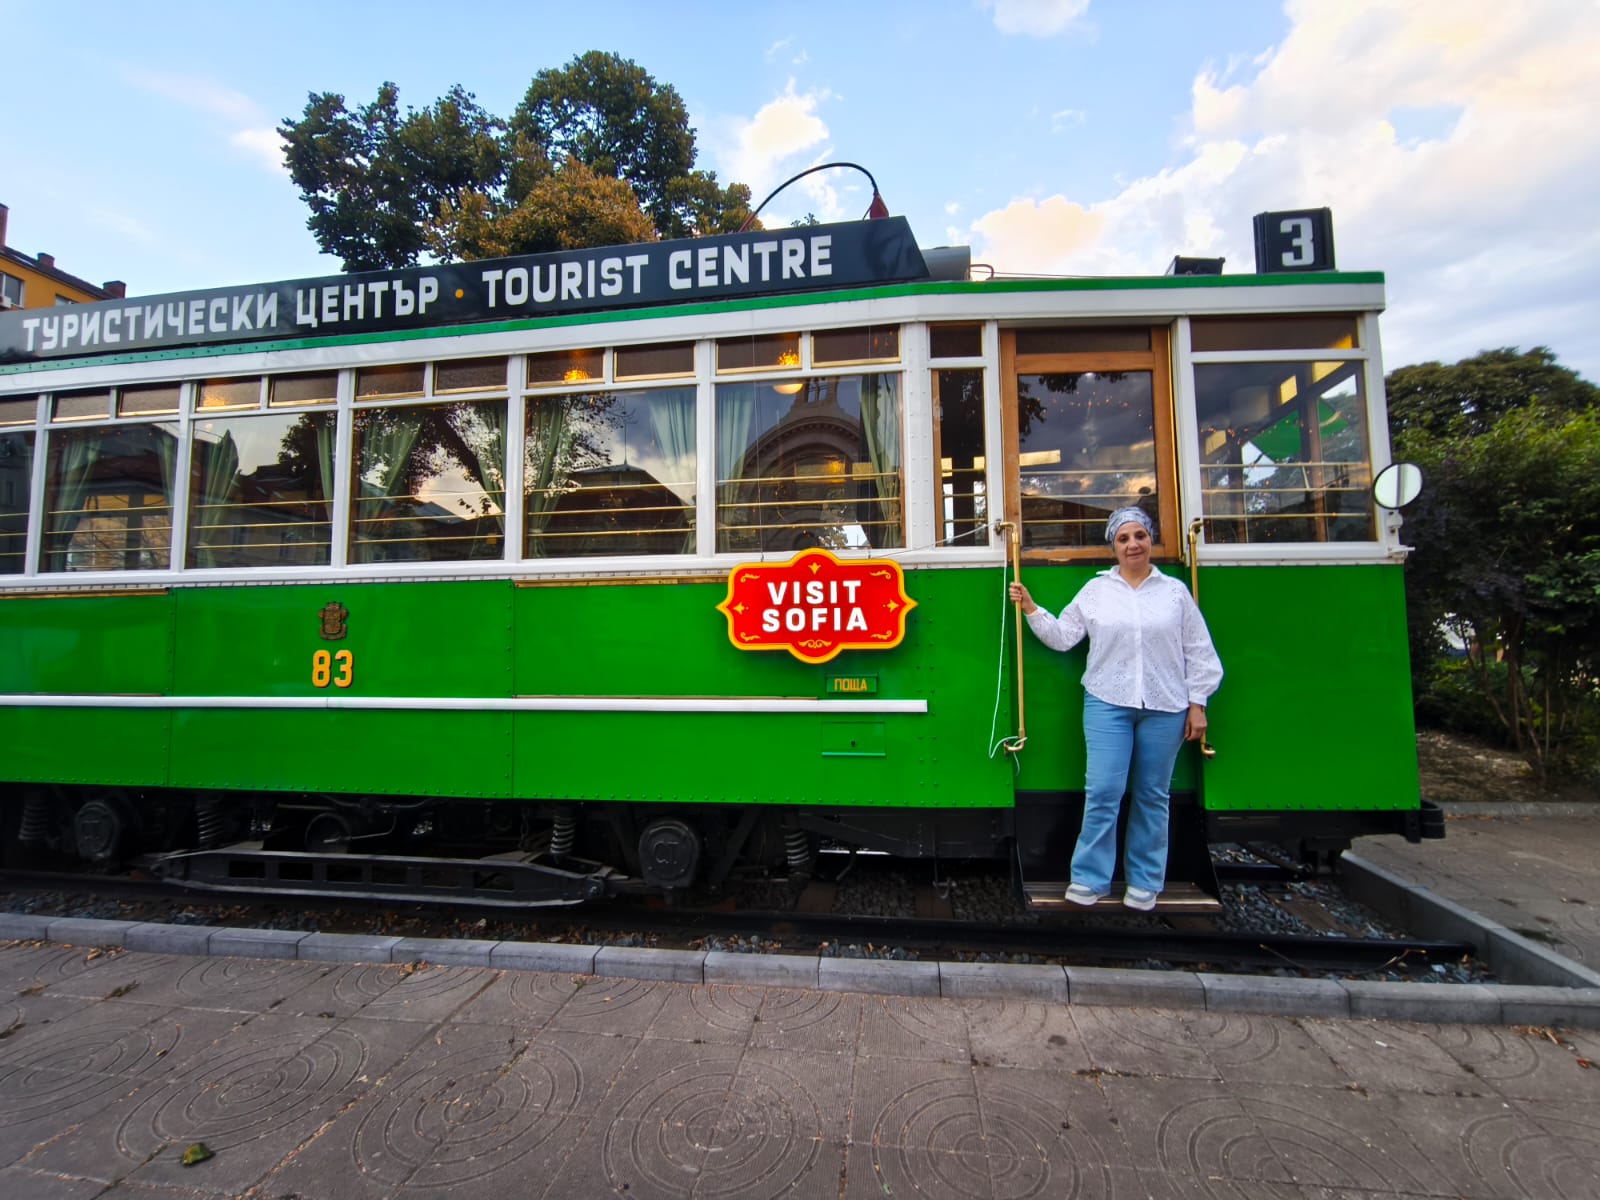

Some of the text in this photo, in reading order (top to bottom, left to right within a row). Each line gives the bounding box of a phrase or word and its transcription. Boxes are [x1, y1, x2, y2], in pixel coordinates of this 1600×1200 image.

[1280, 217, 1316, 267] 3
[482, 235, 832, 308] TOURIST CENTRE
[23, 277, 439, 352] ТУРИСТИЧЕСКИ ЦЕНТЪР
[767, 580, 862, 605] VISIT
[762, 607, 868, 632] SOFIA
[312, 649, 354, 689] 83
[834, 678, 868, 692] ПОЩА
